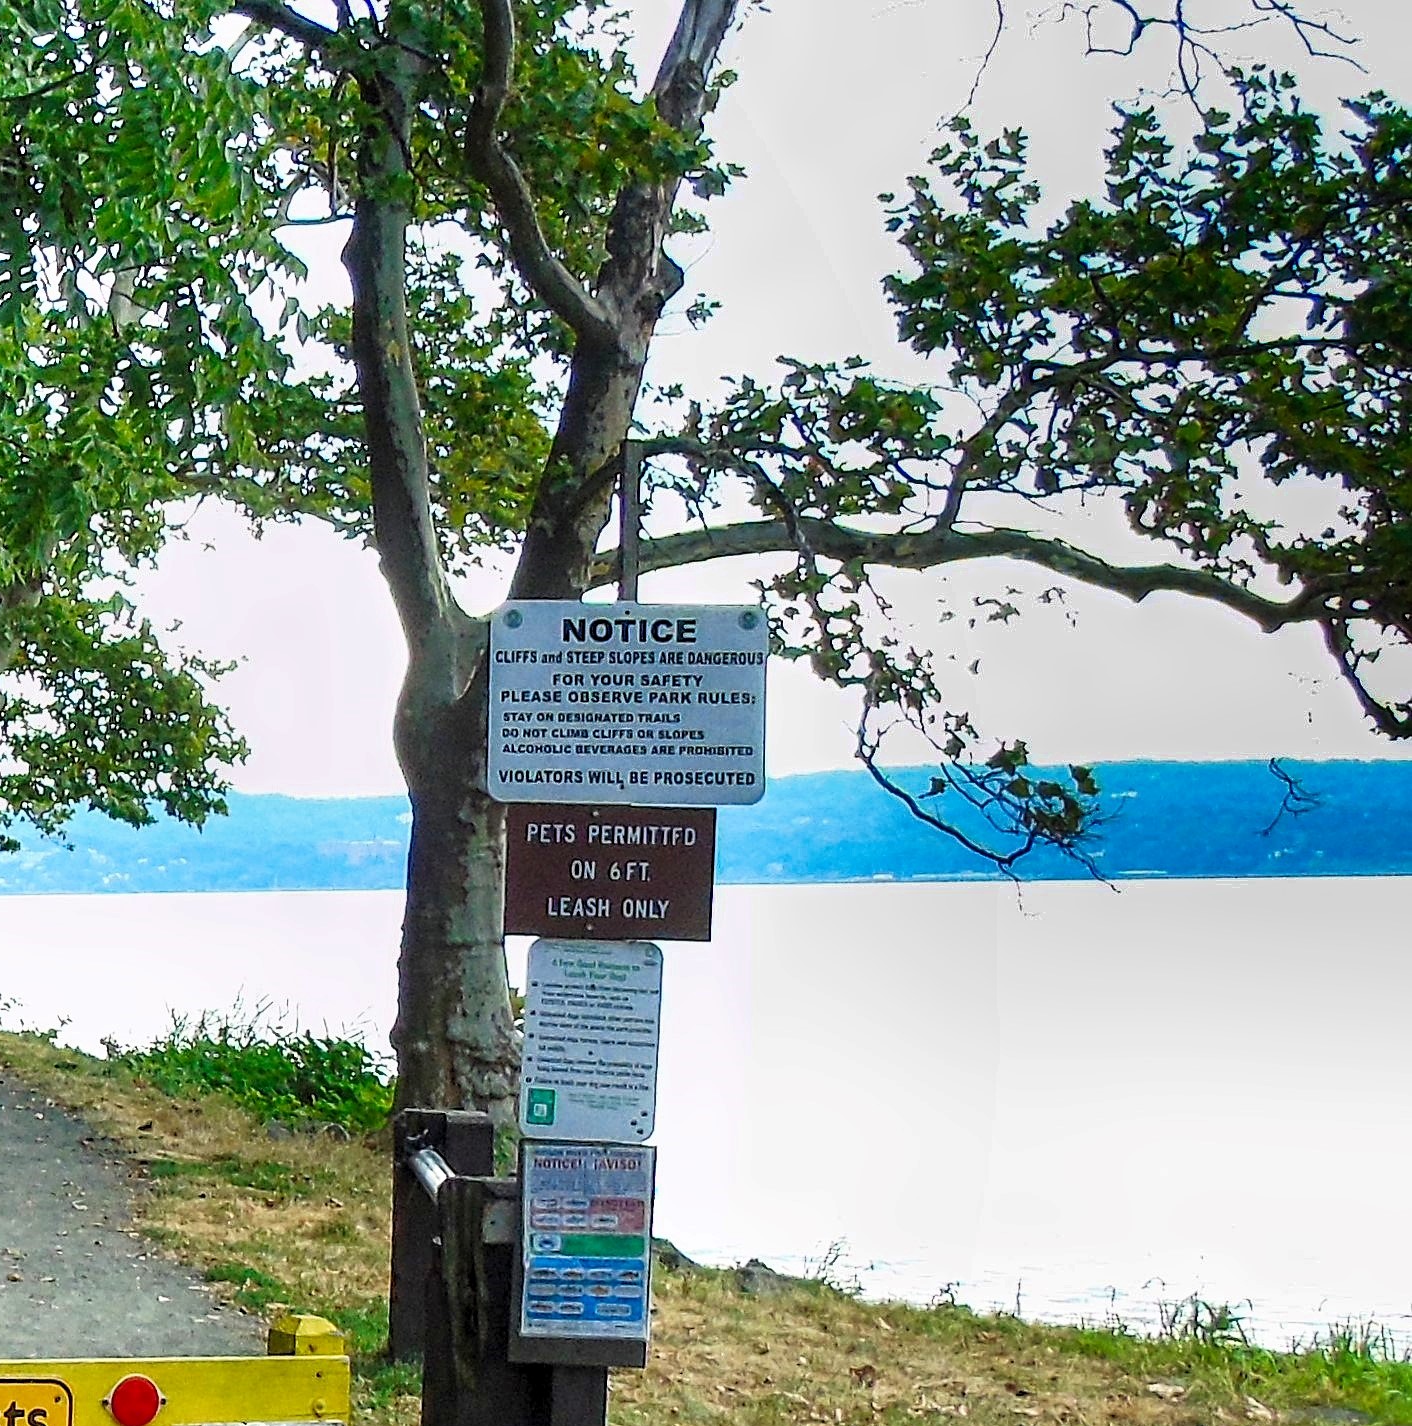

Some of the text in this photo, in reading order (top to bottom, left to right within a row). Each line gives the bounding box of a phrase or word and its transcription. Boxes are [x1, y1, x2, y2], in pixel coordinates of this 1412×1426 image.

[563, 619, 697, 642] NOTICE
[495, 651, 764, 665] CLIFFS and STEEP SLOPES ARE DANGEROUS
[553, 674, 704, 687] FOR YOUR SAFETY
[501, 691, 756, 704] PLEASE OBSERVE PARK RULES:
[504, 712, 680, 723] STAY ON DESIGNATED TRAILS
[502, 728, 704, 739] DO NOT CLIMB CLIFFS OR SLOPES
[503, 745, 752, 756] ALCOHOLIC BEVERAGES ARE PROHIBITED
[499, 771, 755, 785] VIOLATORS WILL BE PROSECUTED
[527, 824, 575, 843] PETS
[571, 862, 596, 880] ON
[547, 898, 669, 918] LEASH ONLY
[534, 1159, 581, 1169] NOTICE!
